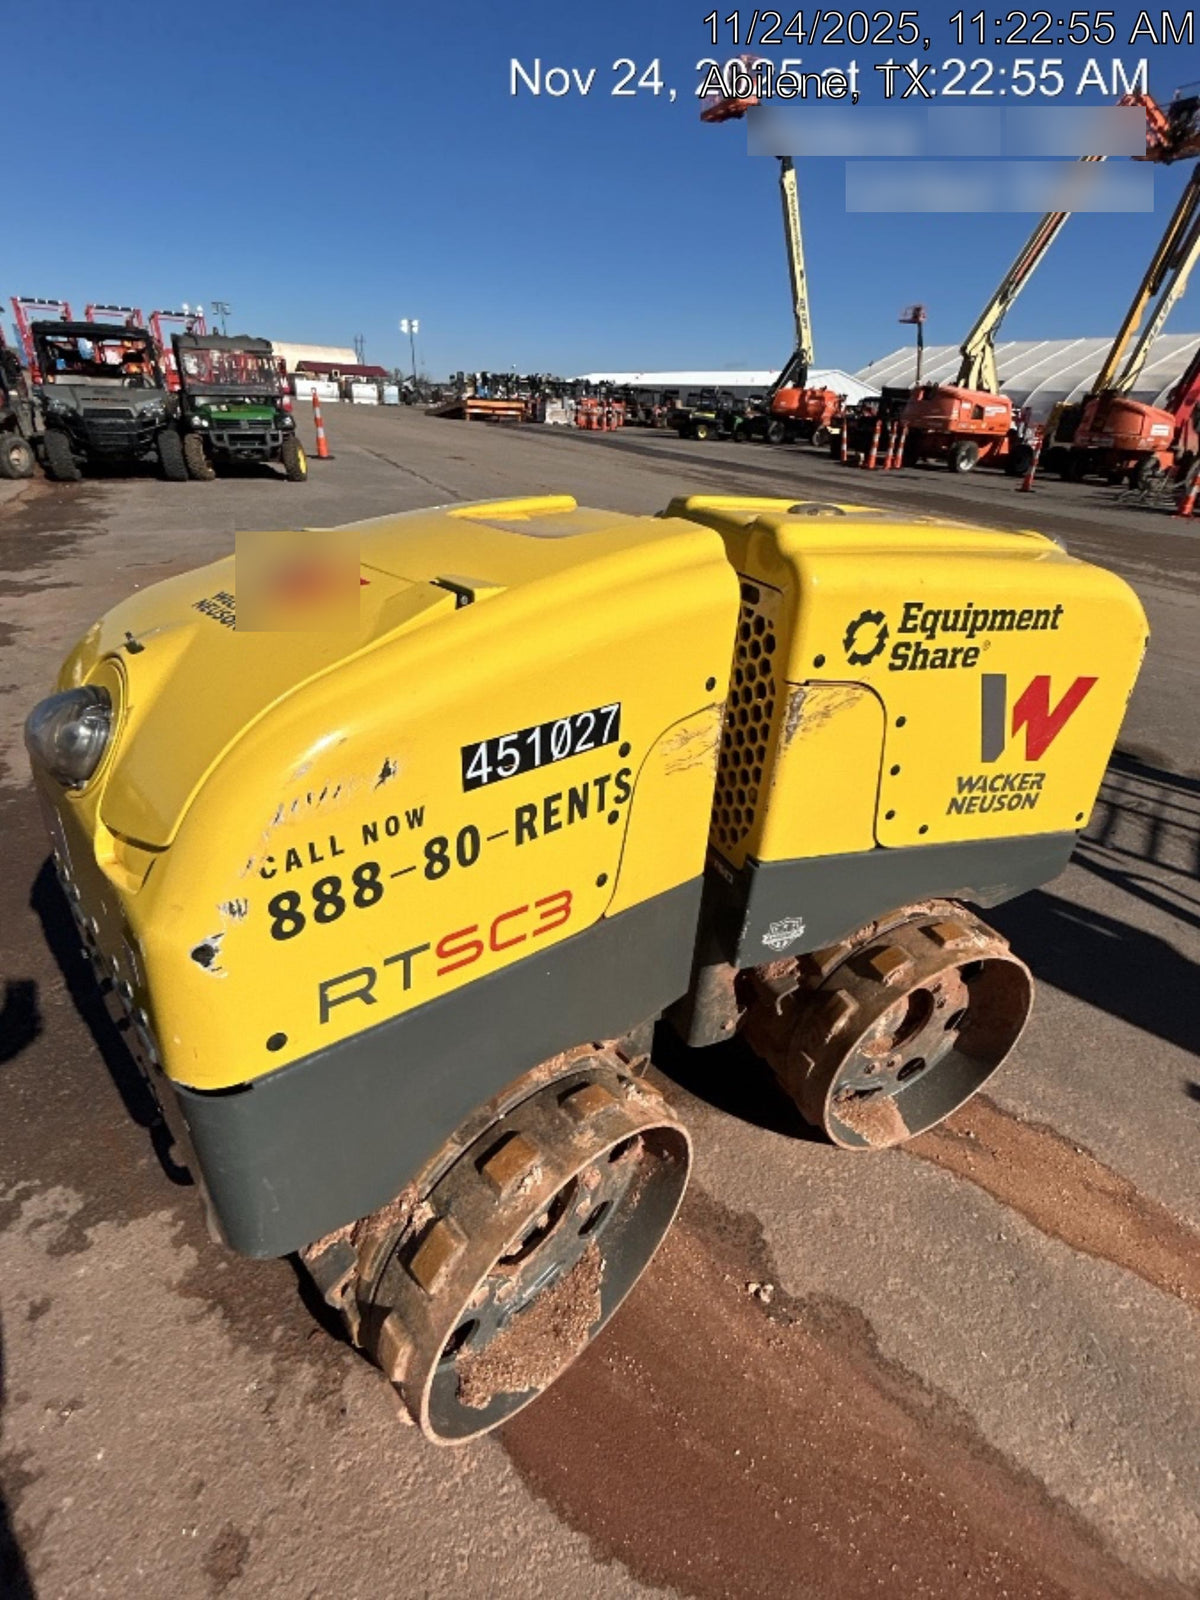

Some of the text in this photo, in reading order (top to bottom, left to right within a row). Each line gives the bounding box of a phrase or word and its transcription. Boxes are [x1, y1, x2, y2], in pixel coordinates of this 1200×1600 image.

[897, 602, 1064, 640] Equipment
[463, 704, 620, 785] 451027
[957, 773, 1046, 794] WACKER
[946, 793, 1039, 815] NEUSON
[259, 805, 425, 879] CALL NOW
